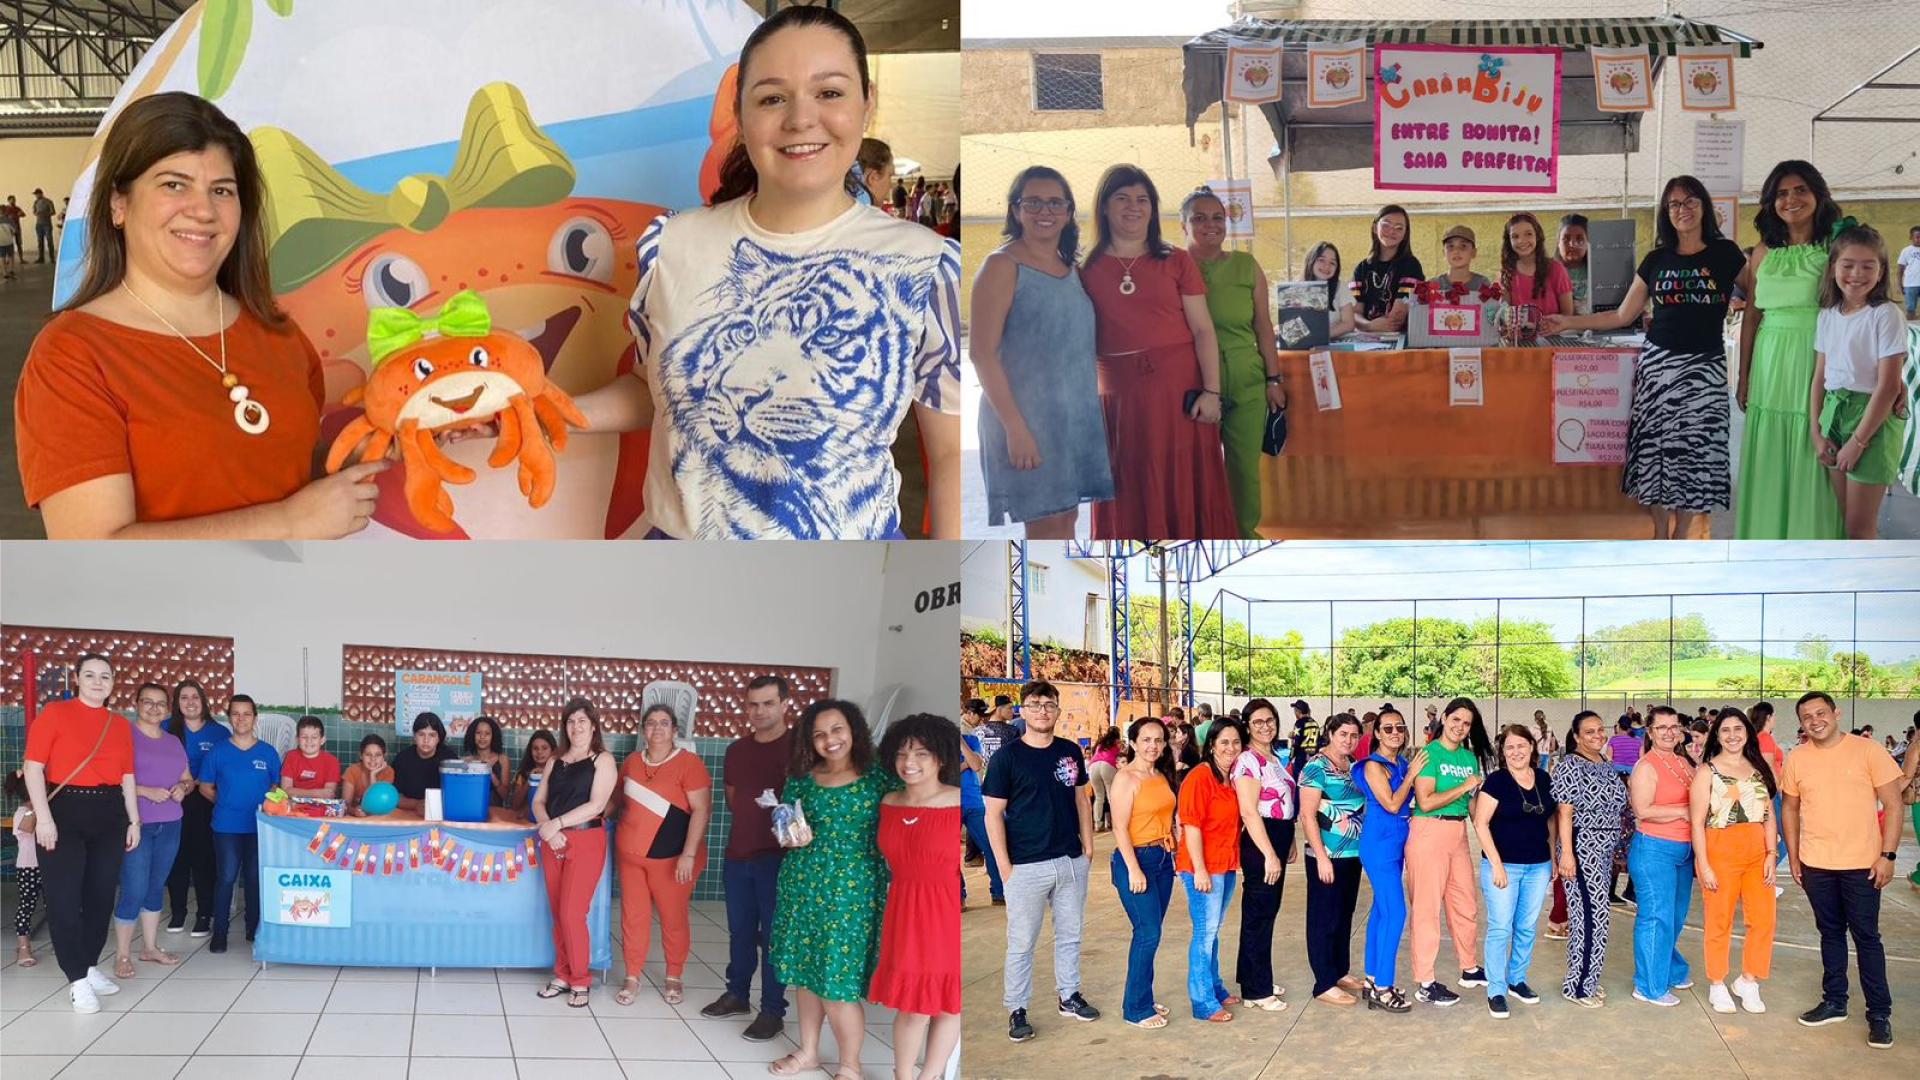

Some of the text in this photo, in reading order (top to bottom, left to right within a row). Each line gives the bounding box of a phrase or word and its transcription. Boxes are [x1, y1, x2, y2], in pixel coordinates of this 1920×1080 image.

[1391, 122, 1541, 145] ENTRE BONITA!
[1403, 150, 1553, 178] SAIA PERFEITA!
[278, 873, 332, 889] CAIXA
